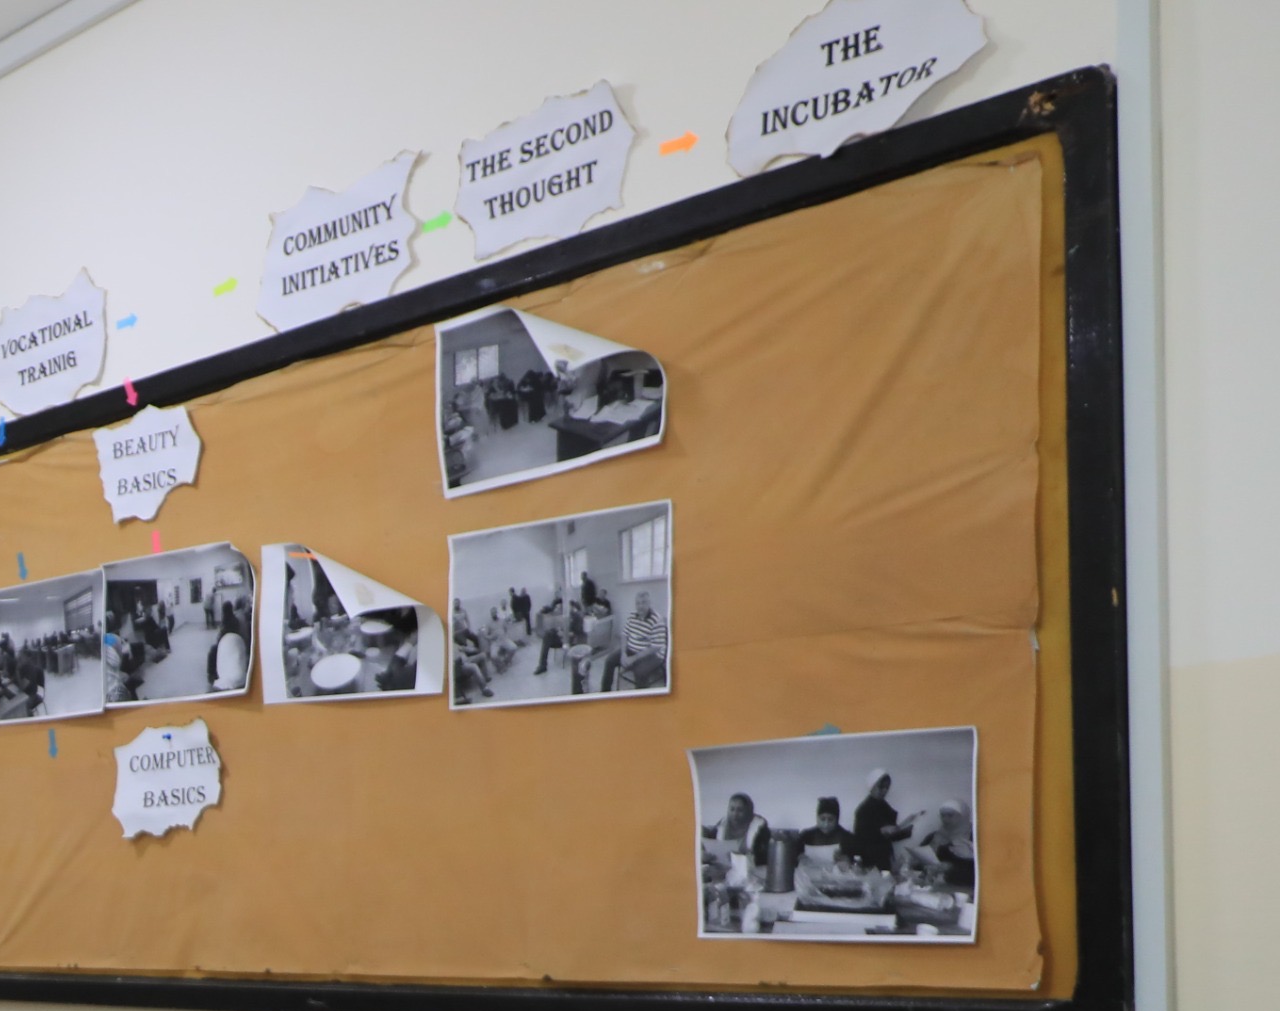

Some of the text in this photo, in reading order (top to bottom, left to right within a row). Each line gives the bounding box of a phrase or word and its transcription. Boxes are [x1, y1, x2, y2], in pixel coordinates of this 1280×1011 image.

[821, 25, 883, 66] THE
[761, 57, 937, 136] INCUBATOR
[466, 109, 613, 182] THE SECOND
[484, 160, 598, 219] THOUGHT
[283, 194, 398, 256] COMMUNITY
[281, 241, 399, 296] INITIATIVES
[1, 311, 93, 358] VOCATIONAL
[18, 351, 77, 386] TRAINIG
[113, 425, 179, 459] BEAUTY
[117, 469, 177, 496] BASICS
[129, 746, 216, 773] COMPUTER
[143, 786, 206, 808] BASICS
